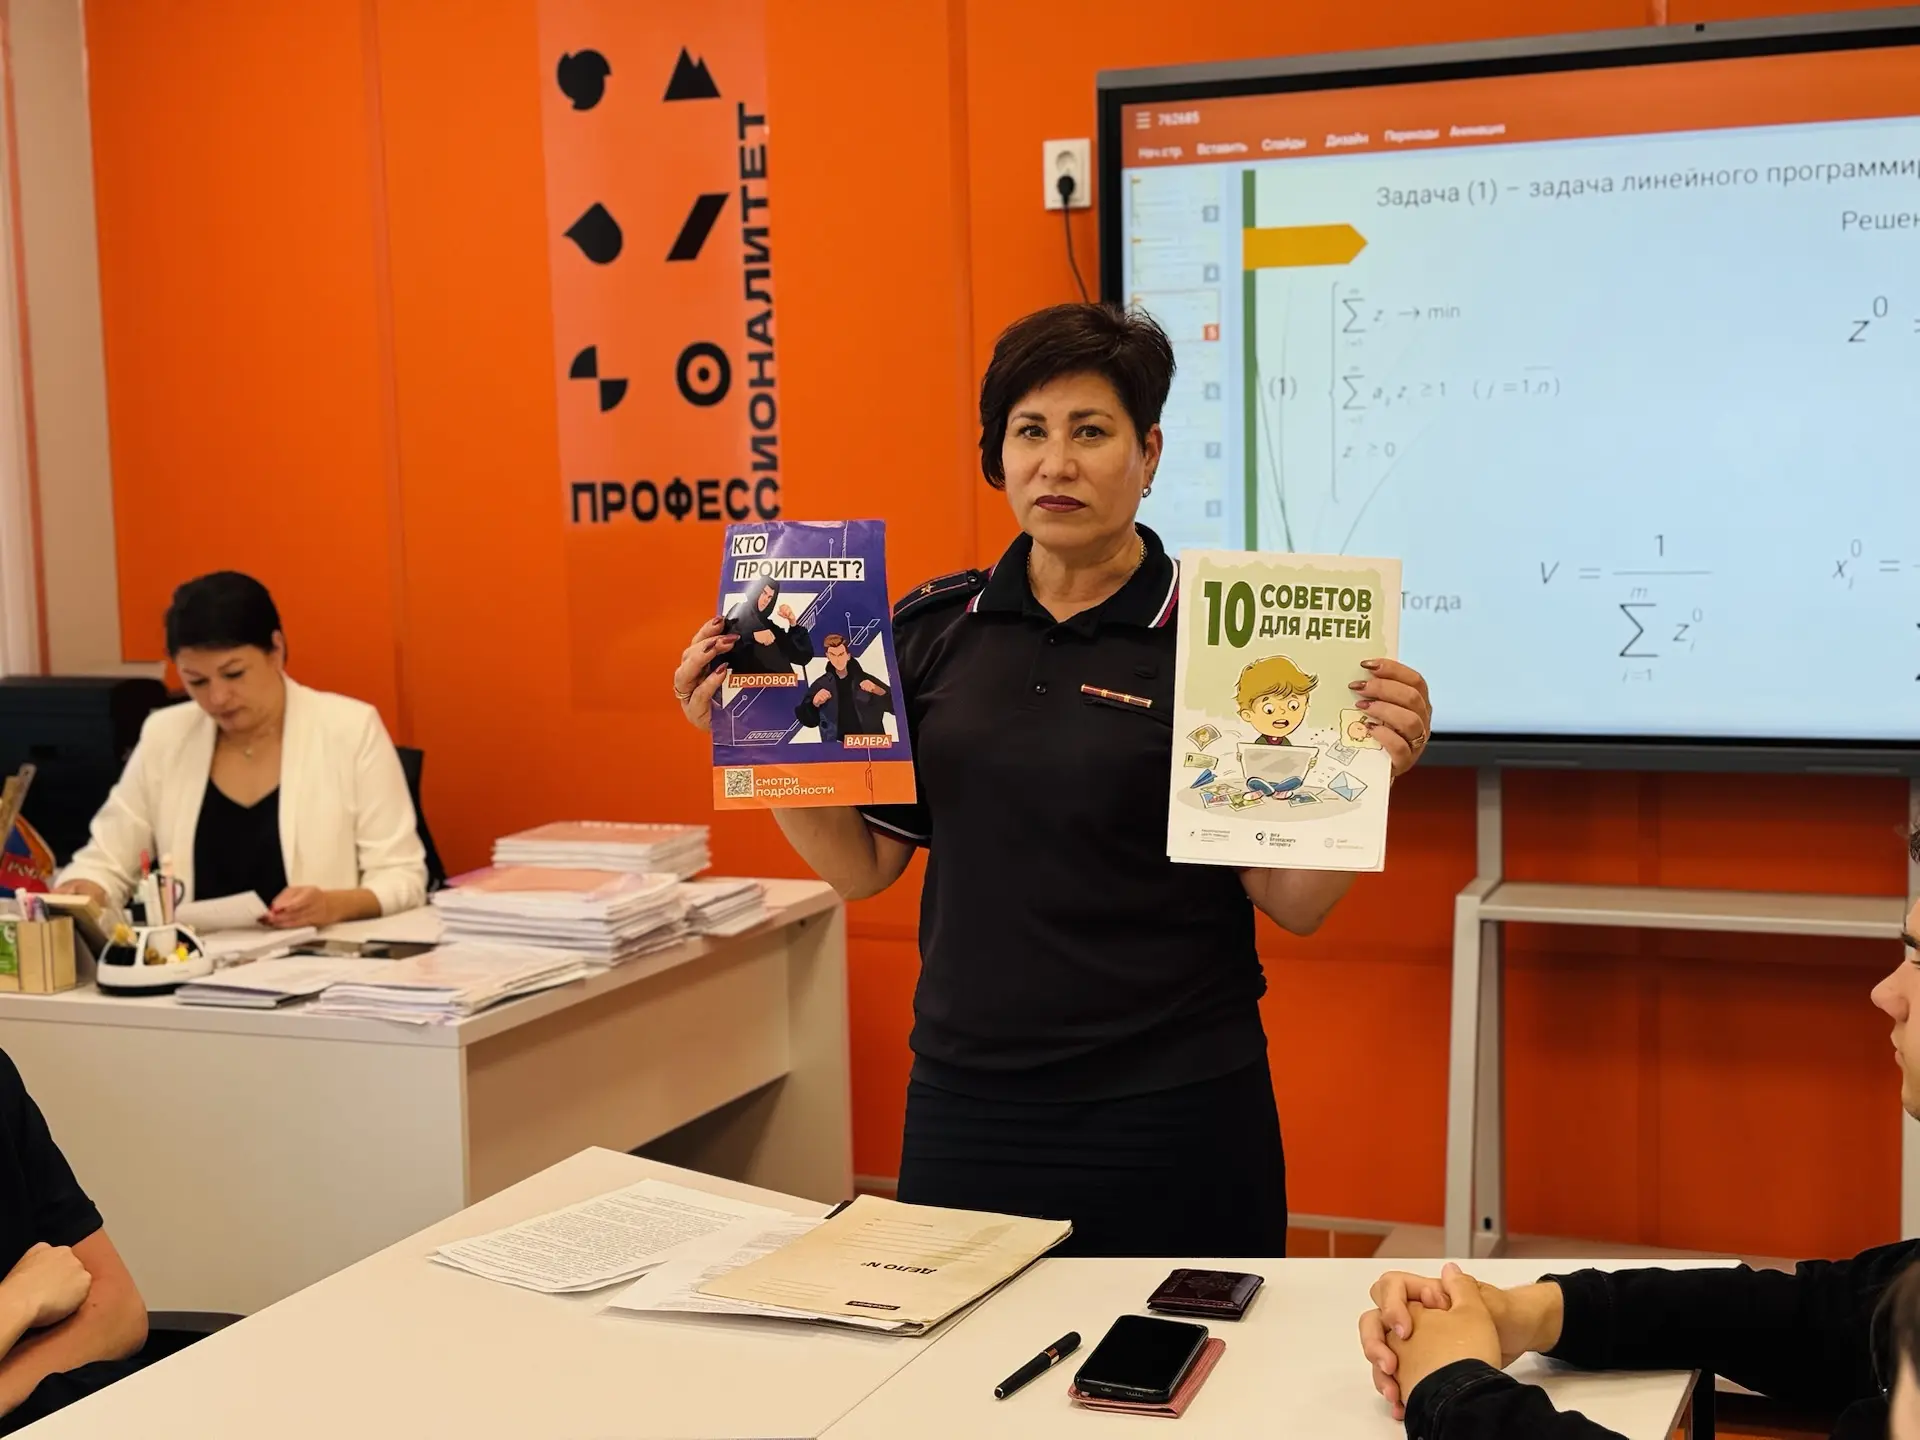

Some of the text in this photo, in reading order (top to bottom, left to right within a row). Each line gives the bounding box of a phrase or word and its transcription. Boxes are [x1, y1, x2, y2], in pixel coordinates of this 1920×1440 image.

[1261, 137, 1308, 151] Слайды
[1325, 131, 1370, 148] Дизайн
[1376, 183, 1460, 209] Задача
[1467, 179, 1498, 207] (1)
[1529, 178, 1615, 200] задача
[1621, 167, 1759, 193] линейного
[1427, 304, 1461, 320] min
[732, 534, 767, 555] КТО
[735, 559, 864, 580] ПРОИГРАЕТ?
[1259, 583, 1373, 613] СОВЕТОВ
[1401, 591, 1462, 614] Тогда
[1203, 580, 1257, 649] 10
[1258, 613, 1372, 641] ДЛЯ ДЕТЕЙ
[729, 674, 797, 689] ДРОПОВОД
[845, 737, 891, 749] ВАЛЕРА
[755, 776, 799, 789] смотри
[756, 786, 836, 799] подробности
[883, 1263, 938, 1275] ДЕЛО
